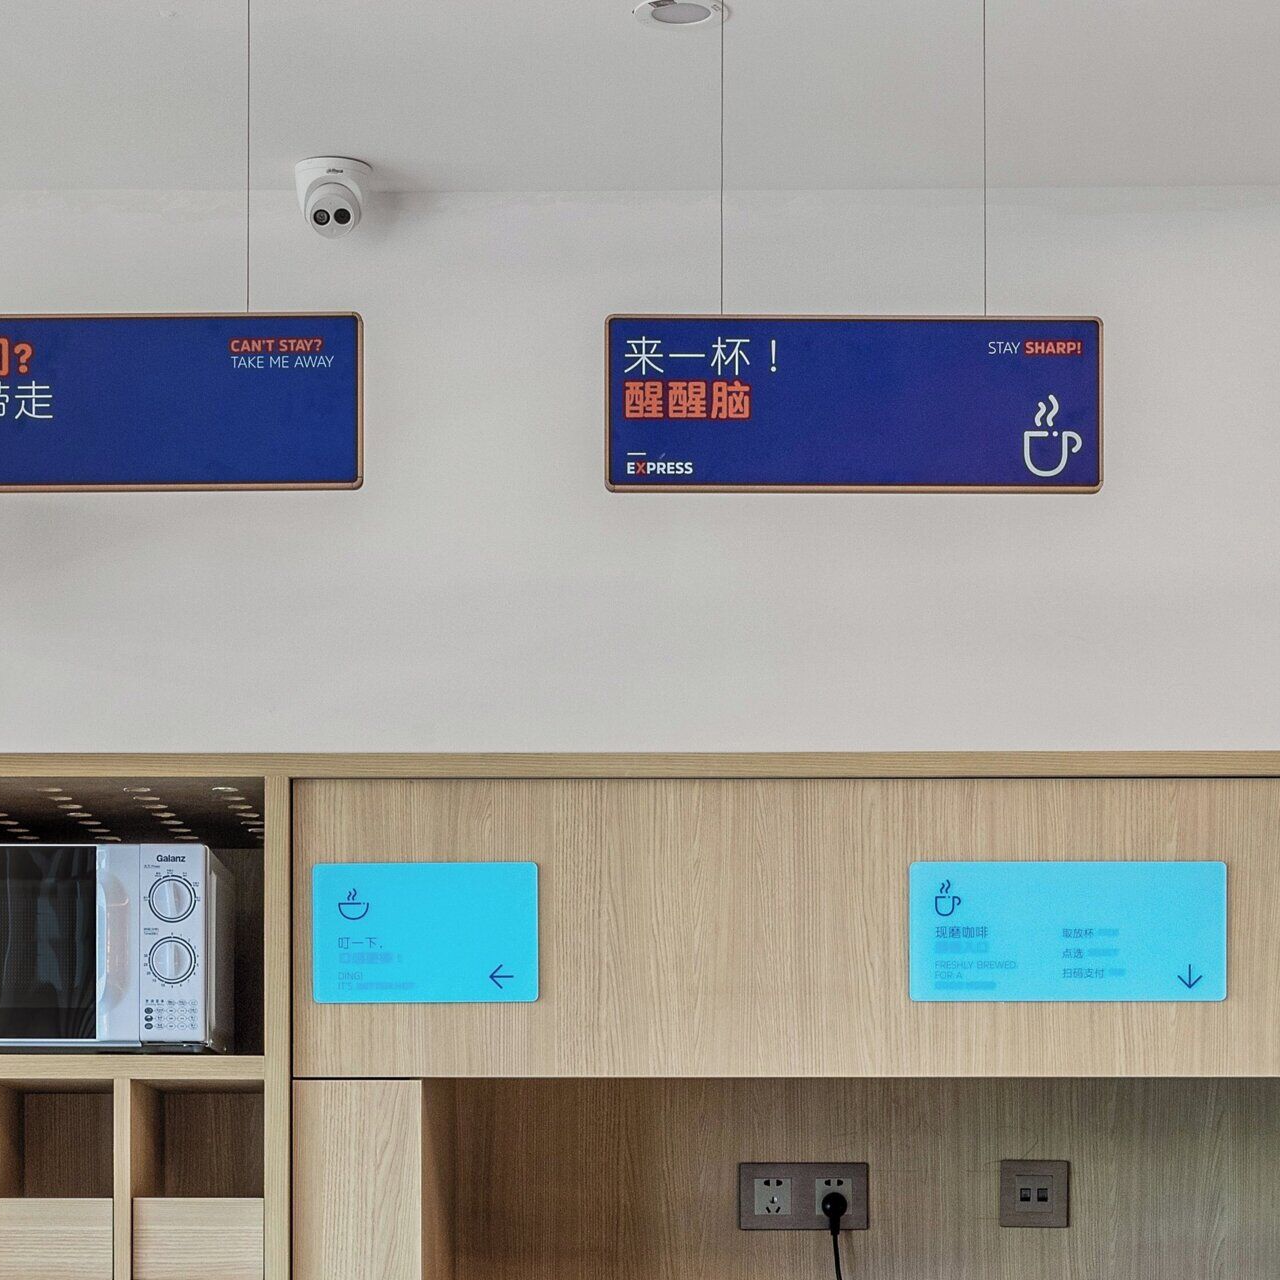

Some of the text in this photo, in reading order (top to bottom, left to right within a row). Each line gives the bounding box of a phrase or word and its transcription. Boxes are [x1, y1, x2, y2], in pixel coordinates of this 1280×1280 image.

[230, 338, 323, 353] CAN'T STAY?
[988, 341, 1082, 355] STAY SHARP!
[231, 355, 335, 369] TAKE ME AWAY
[624, 381, 751, 419] 醒醒脑
[627, 461, 693, 475] EXPRESS
[156, 854, 186, 863] Galanz
[935, 926, 989, 939] 现磨咖啡
[1062, 948, 1084, 959] 点选
[935, 961, 1017, 970] FRESHLY BREWED
[338, 971, 363, 981] DING!
[935, 971, 954, 980] FOR
[1062, 968, 1105, 979] 扫码支付
